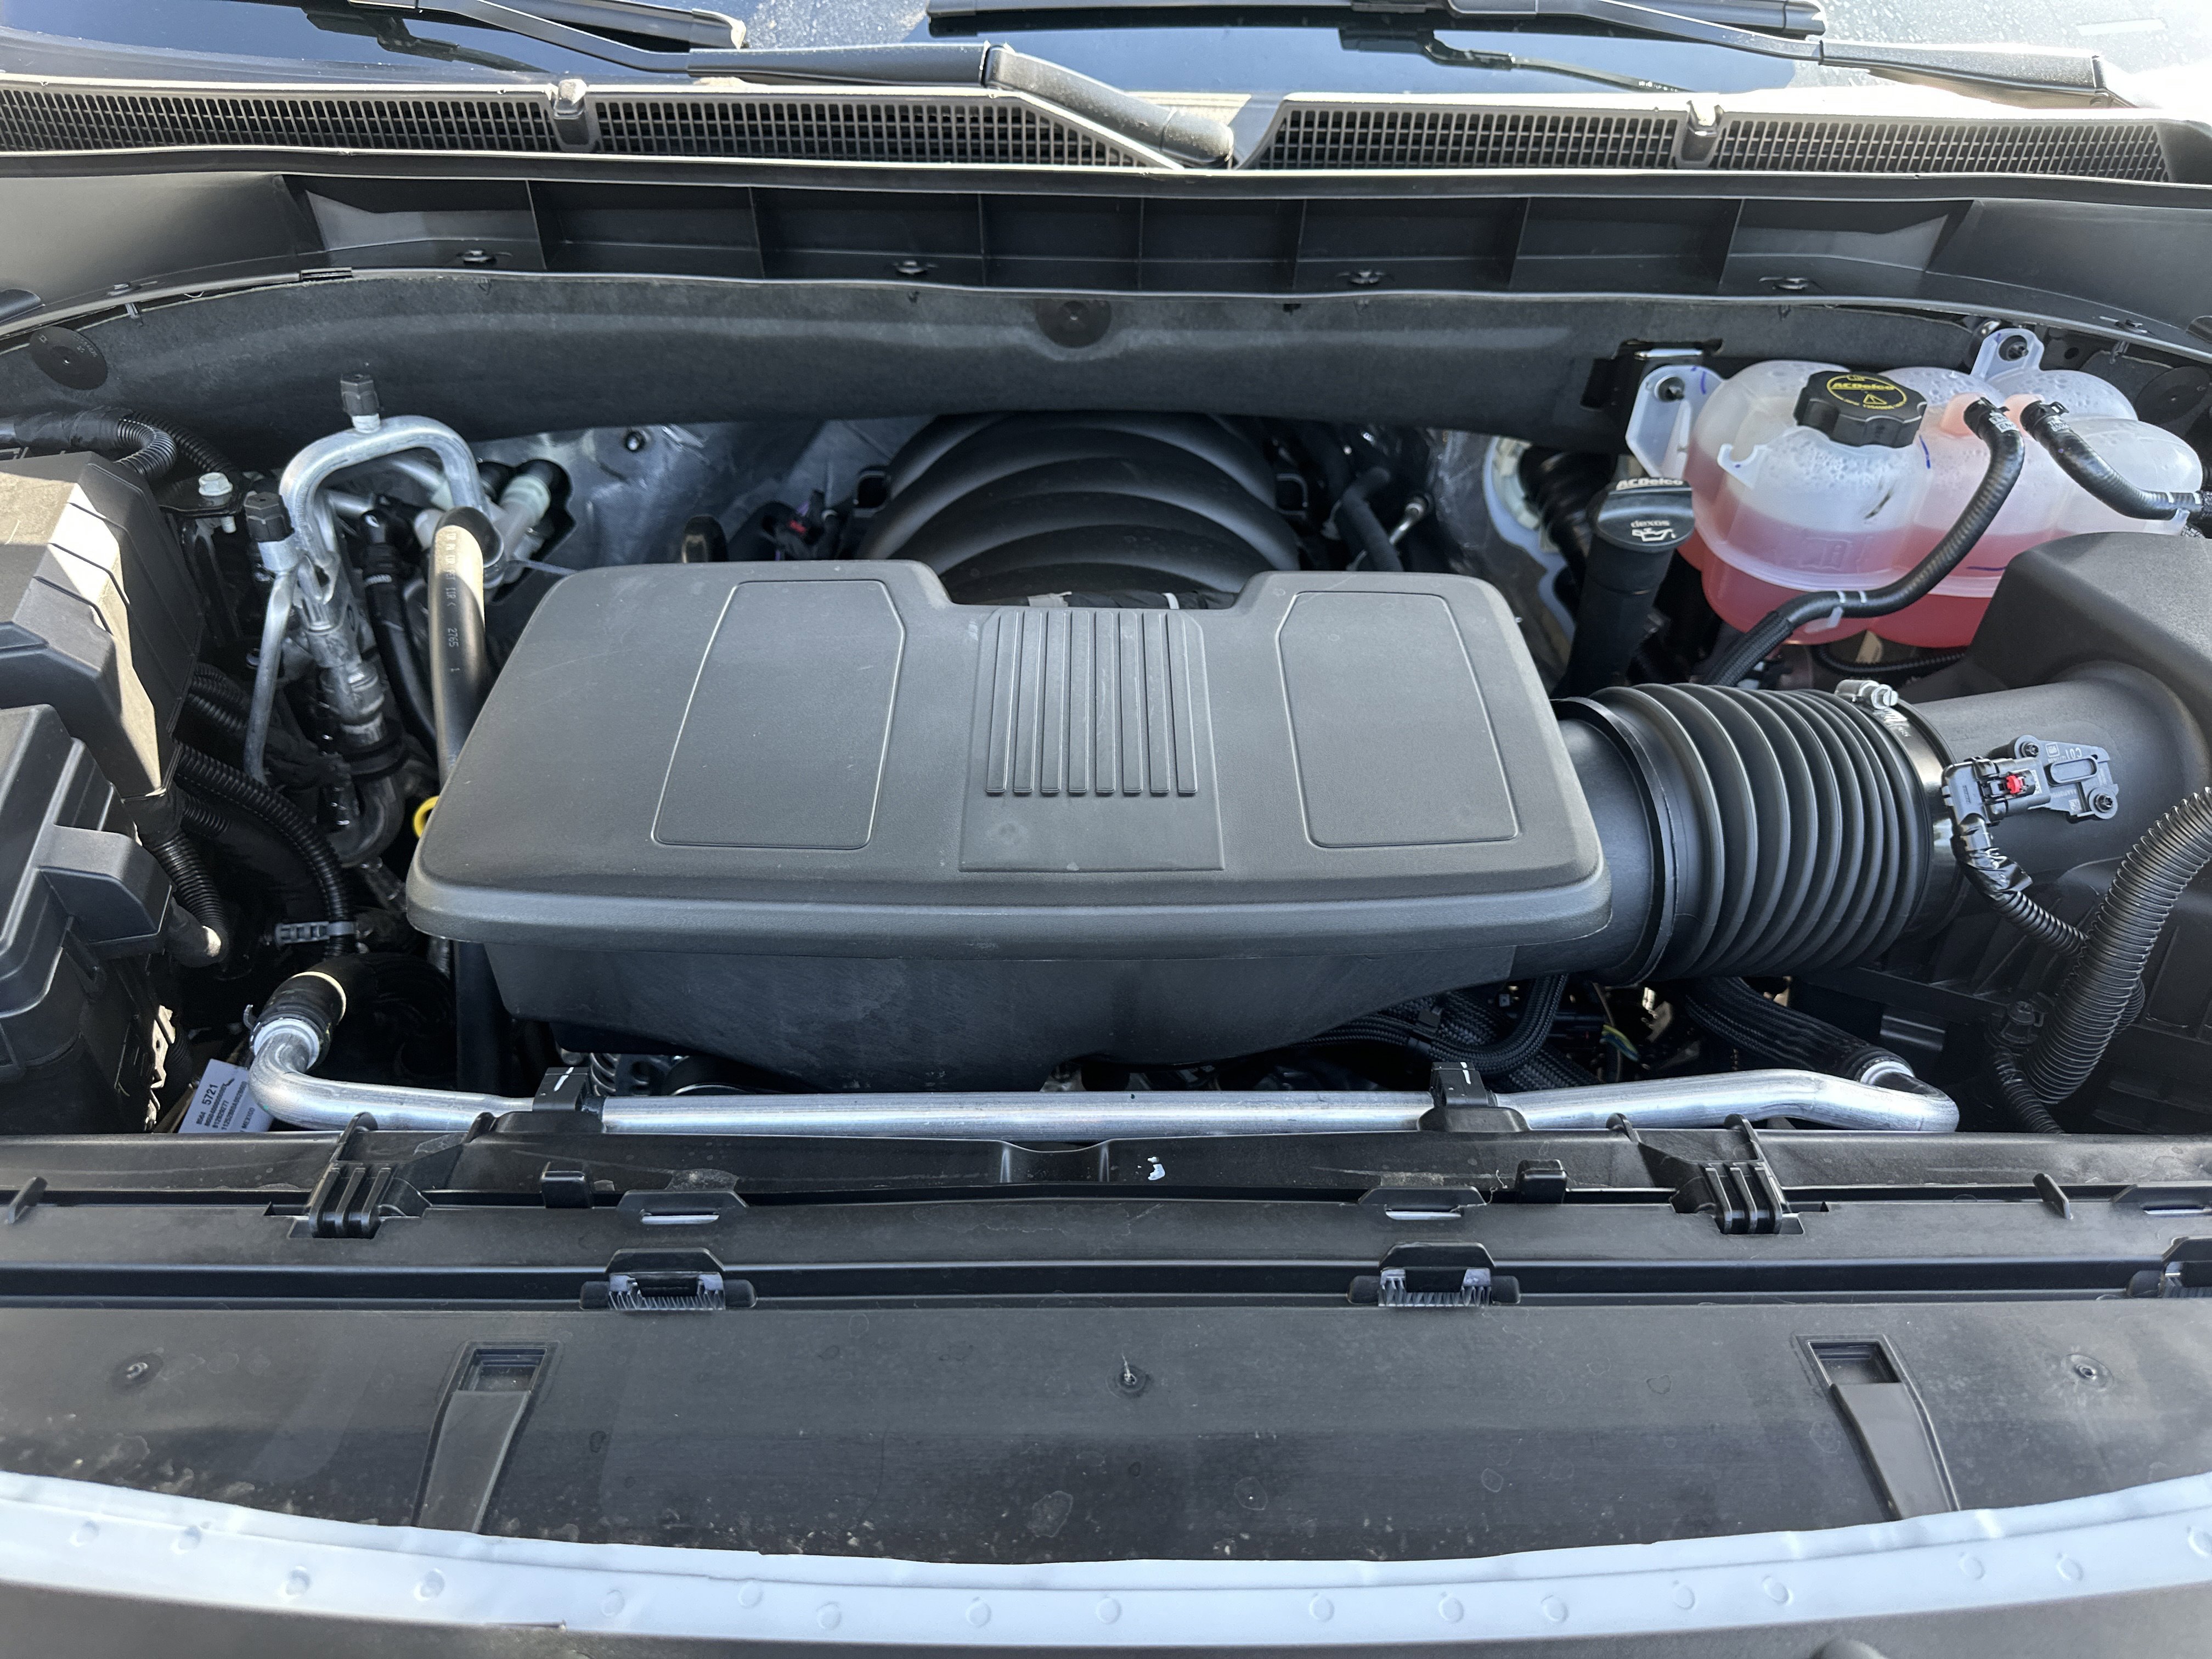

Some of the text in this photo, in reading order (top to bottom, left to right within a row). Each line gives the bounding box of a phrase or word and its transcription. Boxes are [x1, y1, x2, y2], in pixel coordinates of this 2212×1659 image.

[1831, 382, 1895, 391] ACDelco
[1616, 478, 1684, 491] ACDelco
[447, 628, 459, 647] 2765
[201, 1084, 218, 1105] 5721
[241, 1107, 255, 1129] MEXICO
